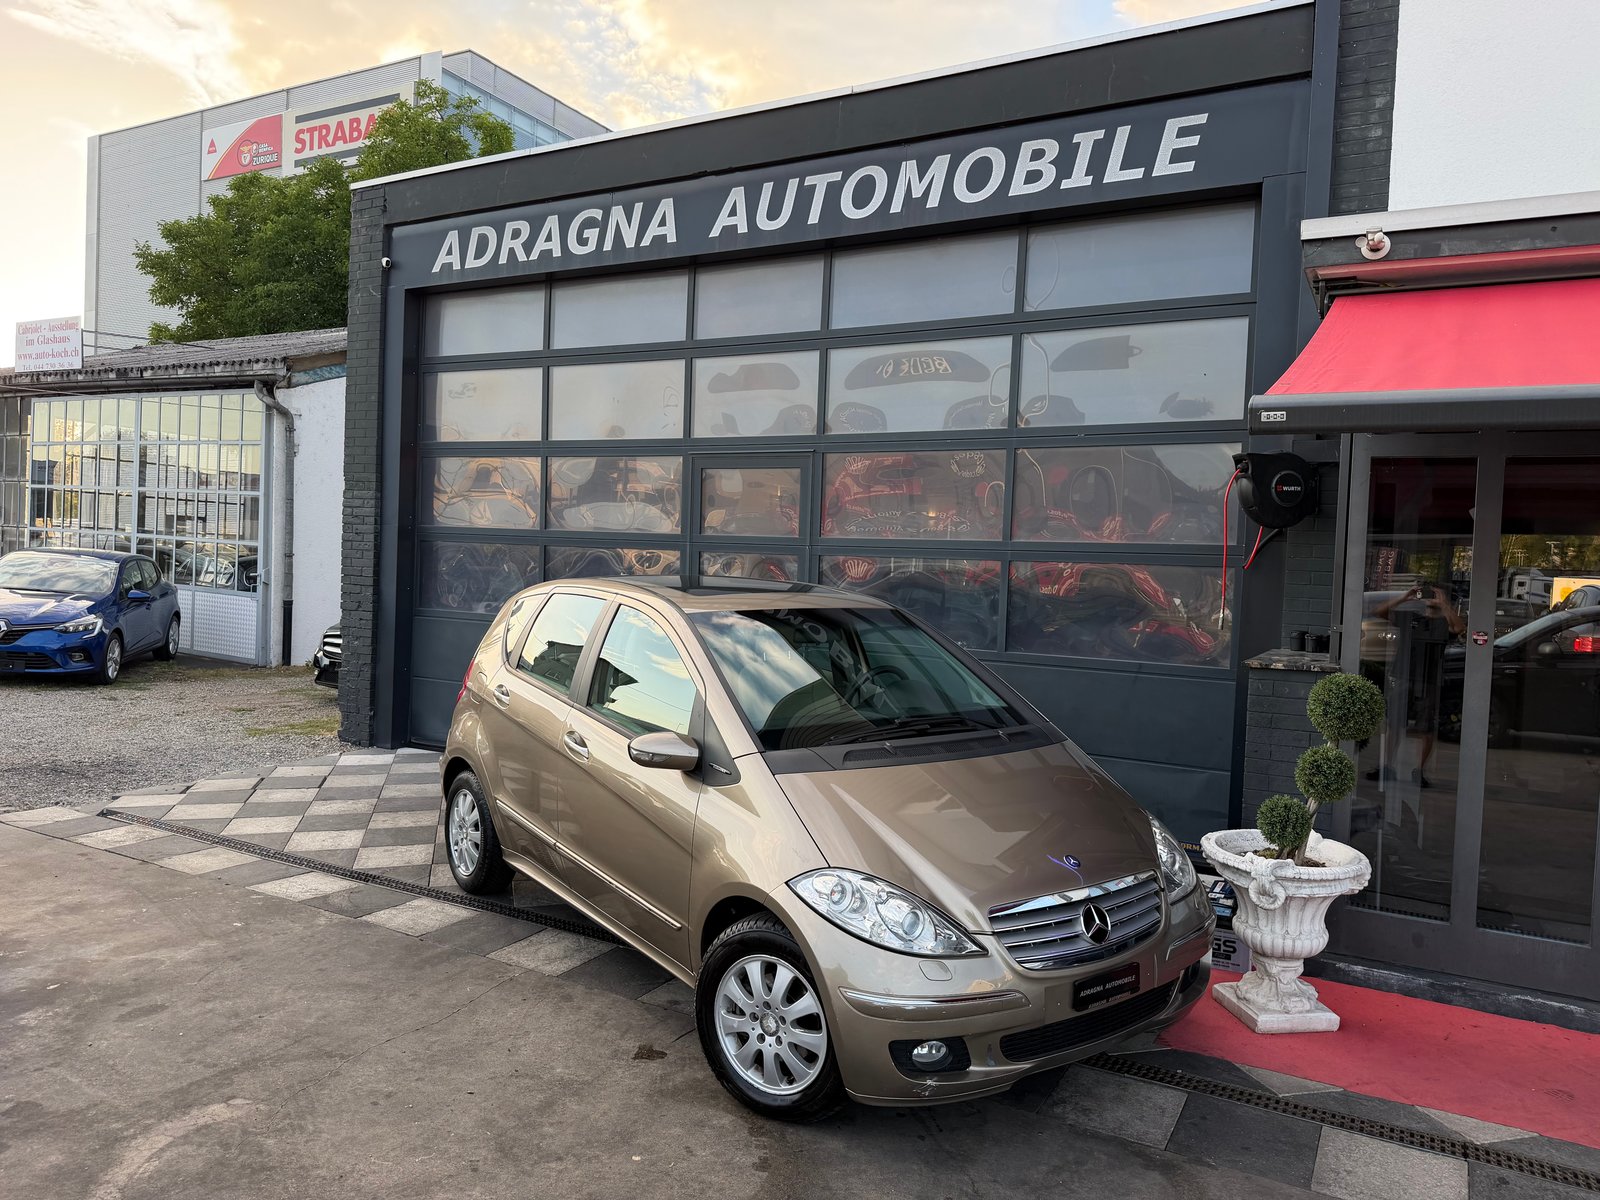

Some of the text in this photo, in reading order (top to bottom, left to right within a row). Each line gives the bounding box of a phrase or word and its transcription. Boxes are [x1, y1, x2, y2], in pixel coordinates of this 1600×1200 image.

[252, 152, 279, 166] ZURIQUE
[431, 112, 1209, 274] ADRAGNA AUTOMOBILE
[25, 334, 71, 346] im Glashaus
[17, 346, 80, 360] www.auto-koch.ch
[1079, 974, 1136, 998] ADRAGNA AUTOMOBILE
